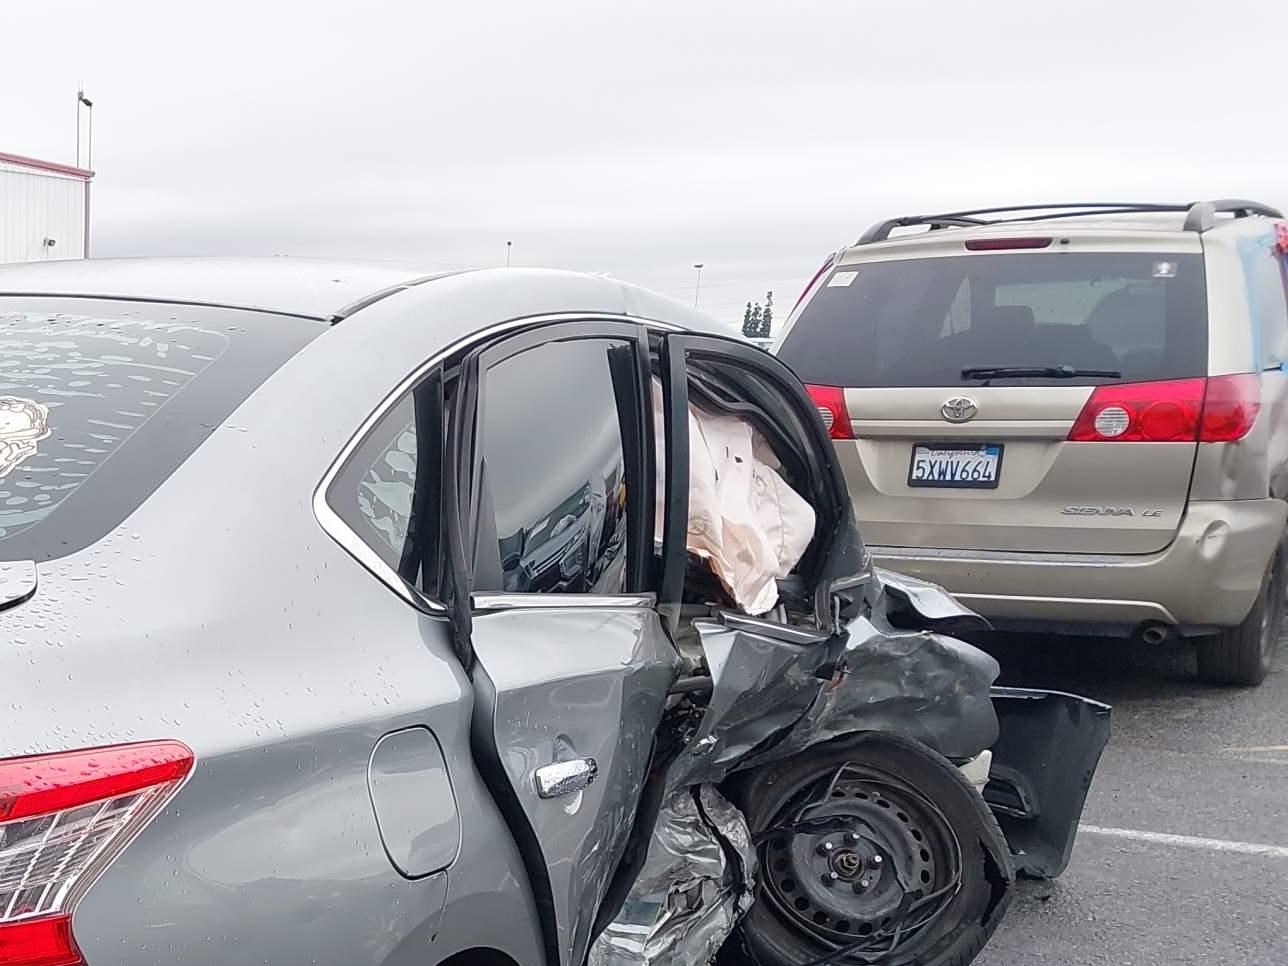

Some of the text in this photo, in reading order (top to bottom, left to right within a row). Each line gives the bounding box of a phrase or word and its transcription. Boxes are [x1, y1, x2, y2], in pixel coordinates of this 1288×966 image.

[915, 459, 992, 481] 5XWV664
[1060, 505, 1164, 517] SIENNA LE
